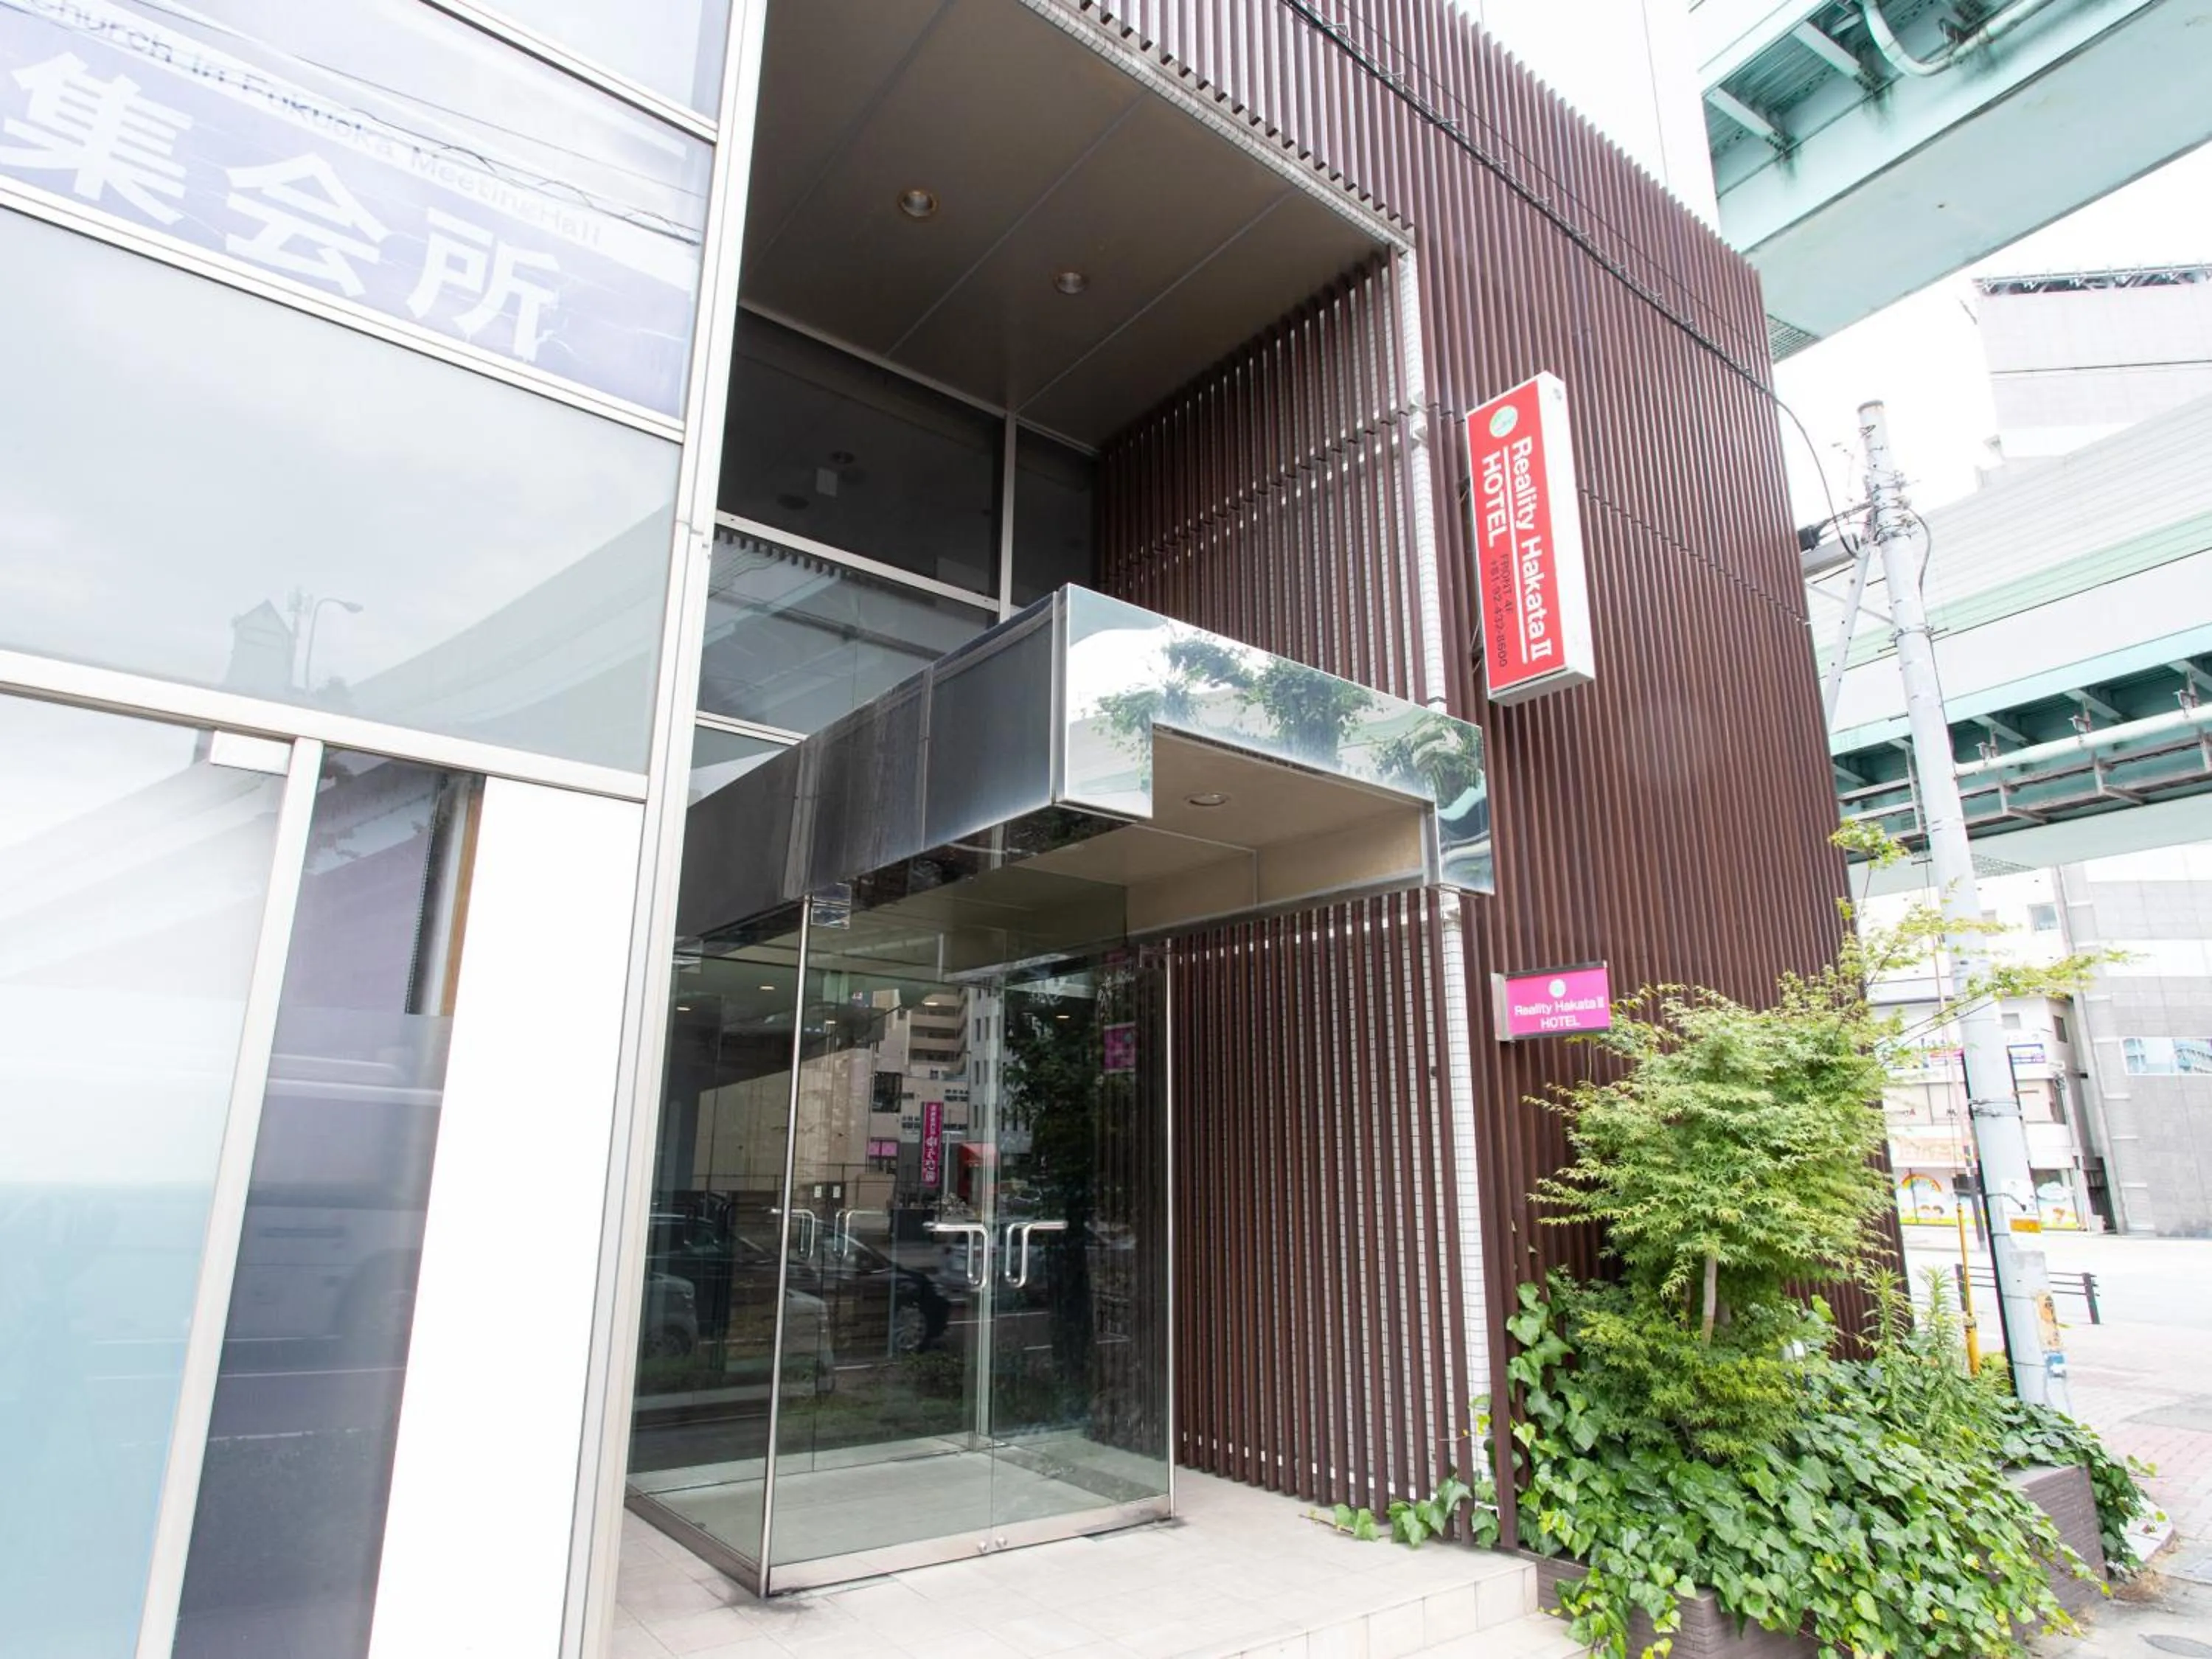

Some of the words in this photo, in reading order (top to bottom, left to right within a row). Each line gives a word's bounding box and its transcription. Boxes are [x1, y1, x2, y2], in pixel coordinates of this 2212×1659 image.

[190, 54, 226, 83] in
[0, 52, 560, 362] 集会所
[1482, 450, 1508, 548] HOTEL
[1512, 436, 1537, 529] Reality
[1521, 535, 1547, 639] Hakata
[1514, 1004, 1552, 1016] Reality
[1556, 998, 1596, 1012] Hakata
[1541, 1015, 1580, 1028] HOTEL
